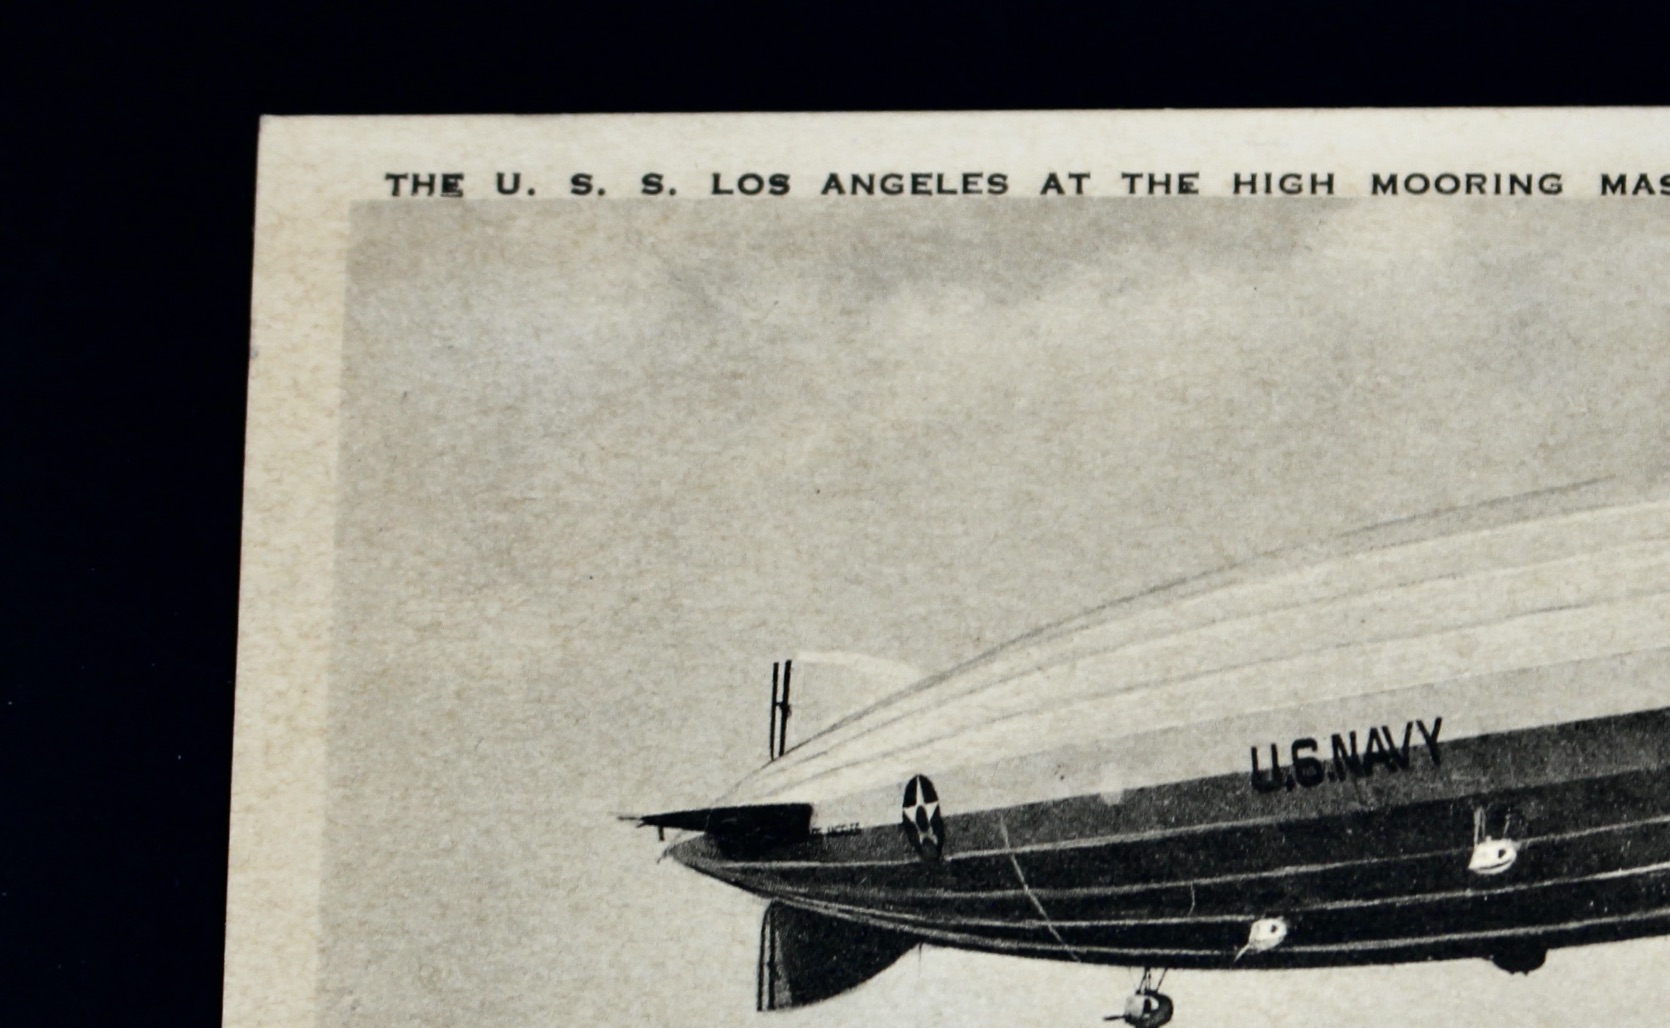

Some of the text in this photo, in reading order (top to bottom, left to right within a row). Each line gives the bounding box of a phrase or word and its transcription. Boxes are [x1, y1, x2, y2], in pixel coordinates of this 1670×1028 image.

[385, 173, 464, 198] THE
[497, 173, 535, 195] U.
[571, 174, 605, 196] S.
[642, 173, 676, 195] S.
[712, 173, 790, 196] LOS
[821, 173, 1008, 196] ANGELES
[1041, 173, 1090, 195] AT
[1122, 173, 1199, 194] THE
[1234, 173, 1333, 195] HIGH
[1372, 174, 1562, 195] MOORING
